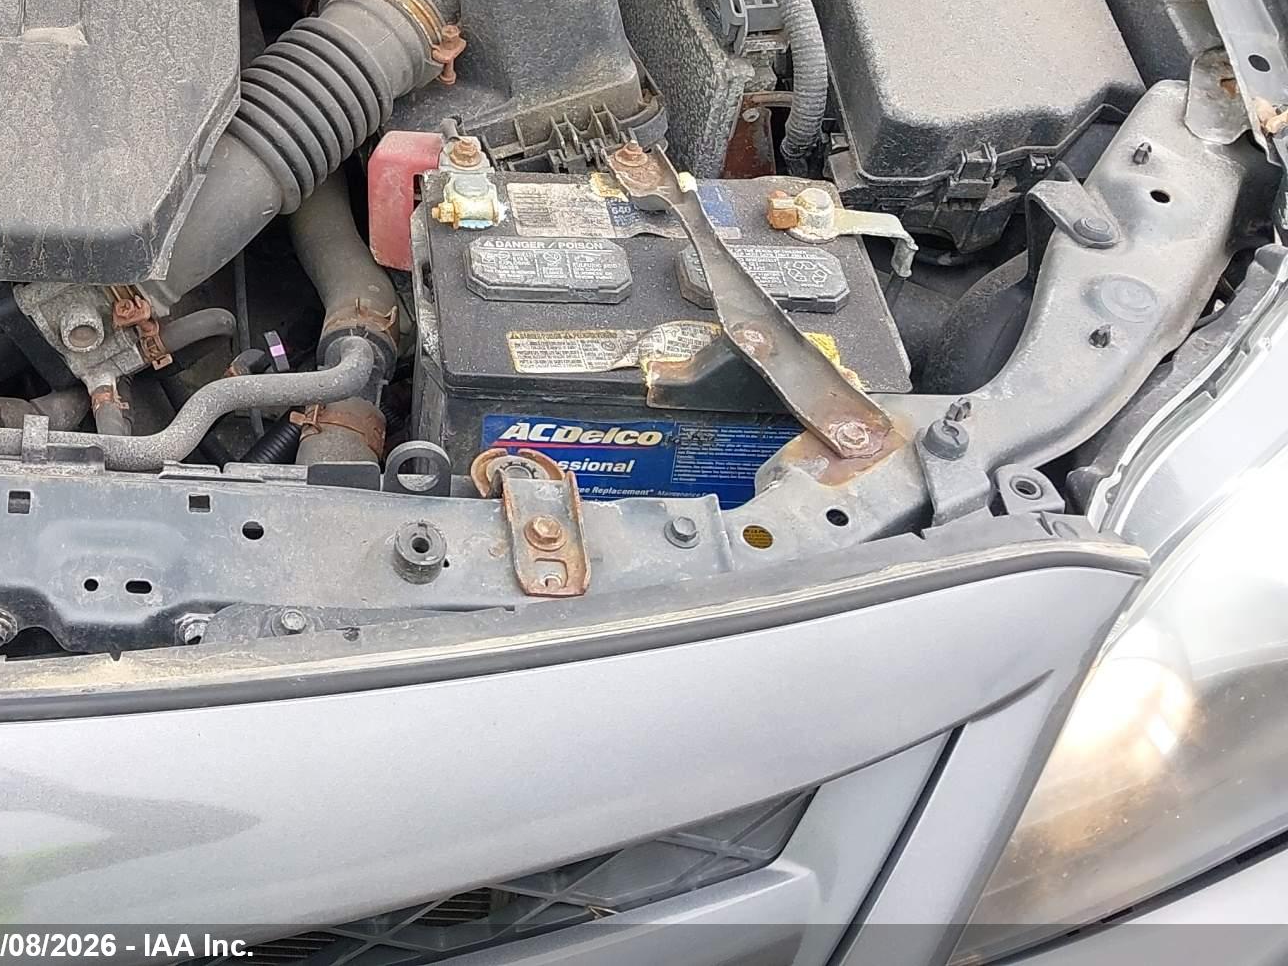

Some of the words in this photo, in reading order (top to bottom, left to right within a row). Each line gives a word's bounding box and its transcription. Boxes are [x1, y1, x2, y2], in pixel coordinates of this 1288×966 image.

[495, 240, 545, 249] DANGER
[558, 241, 603, 250] POISON
[499, 422, 663, 447] ACDelco
[557, 457, 636, 473] ssional
